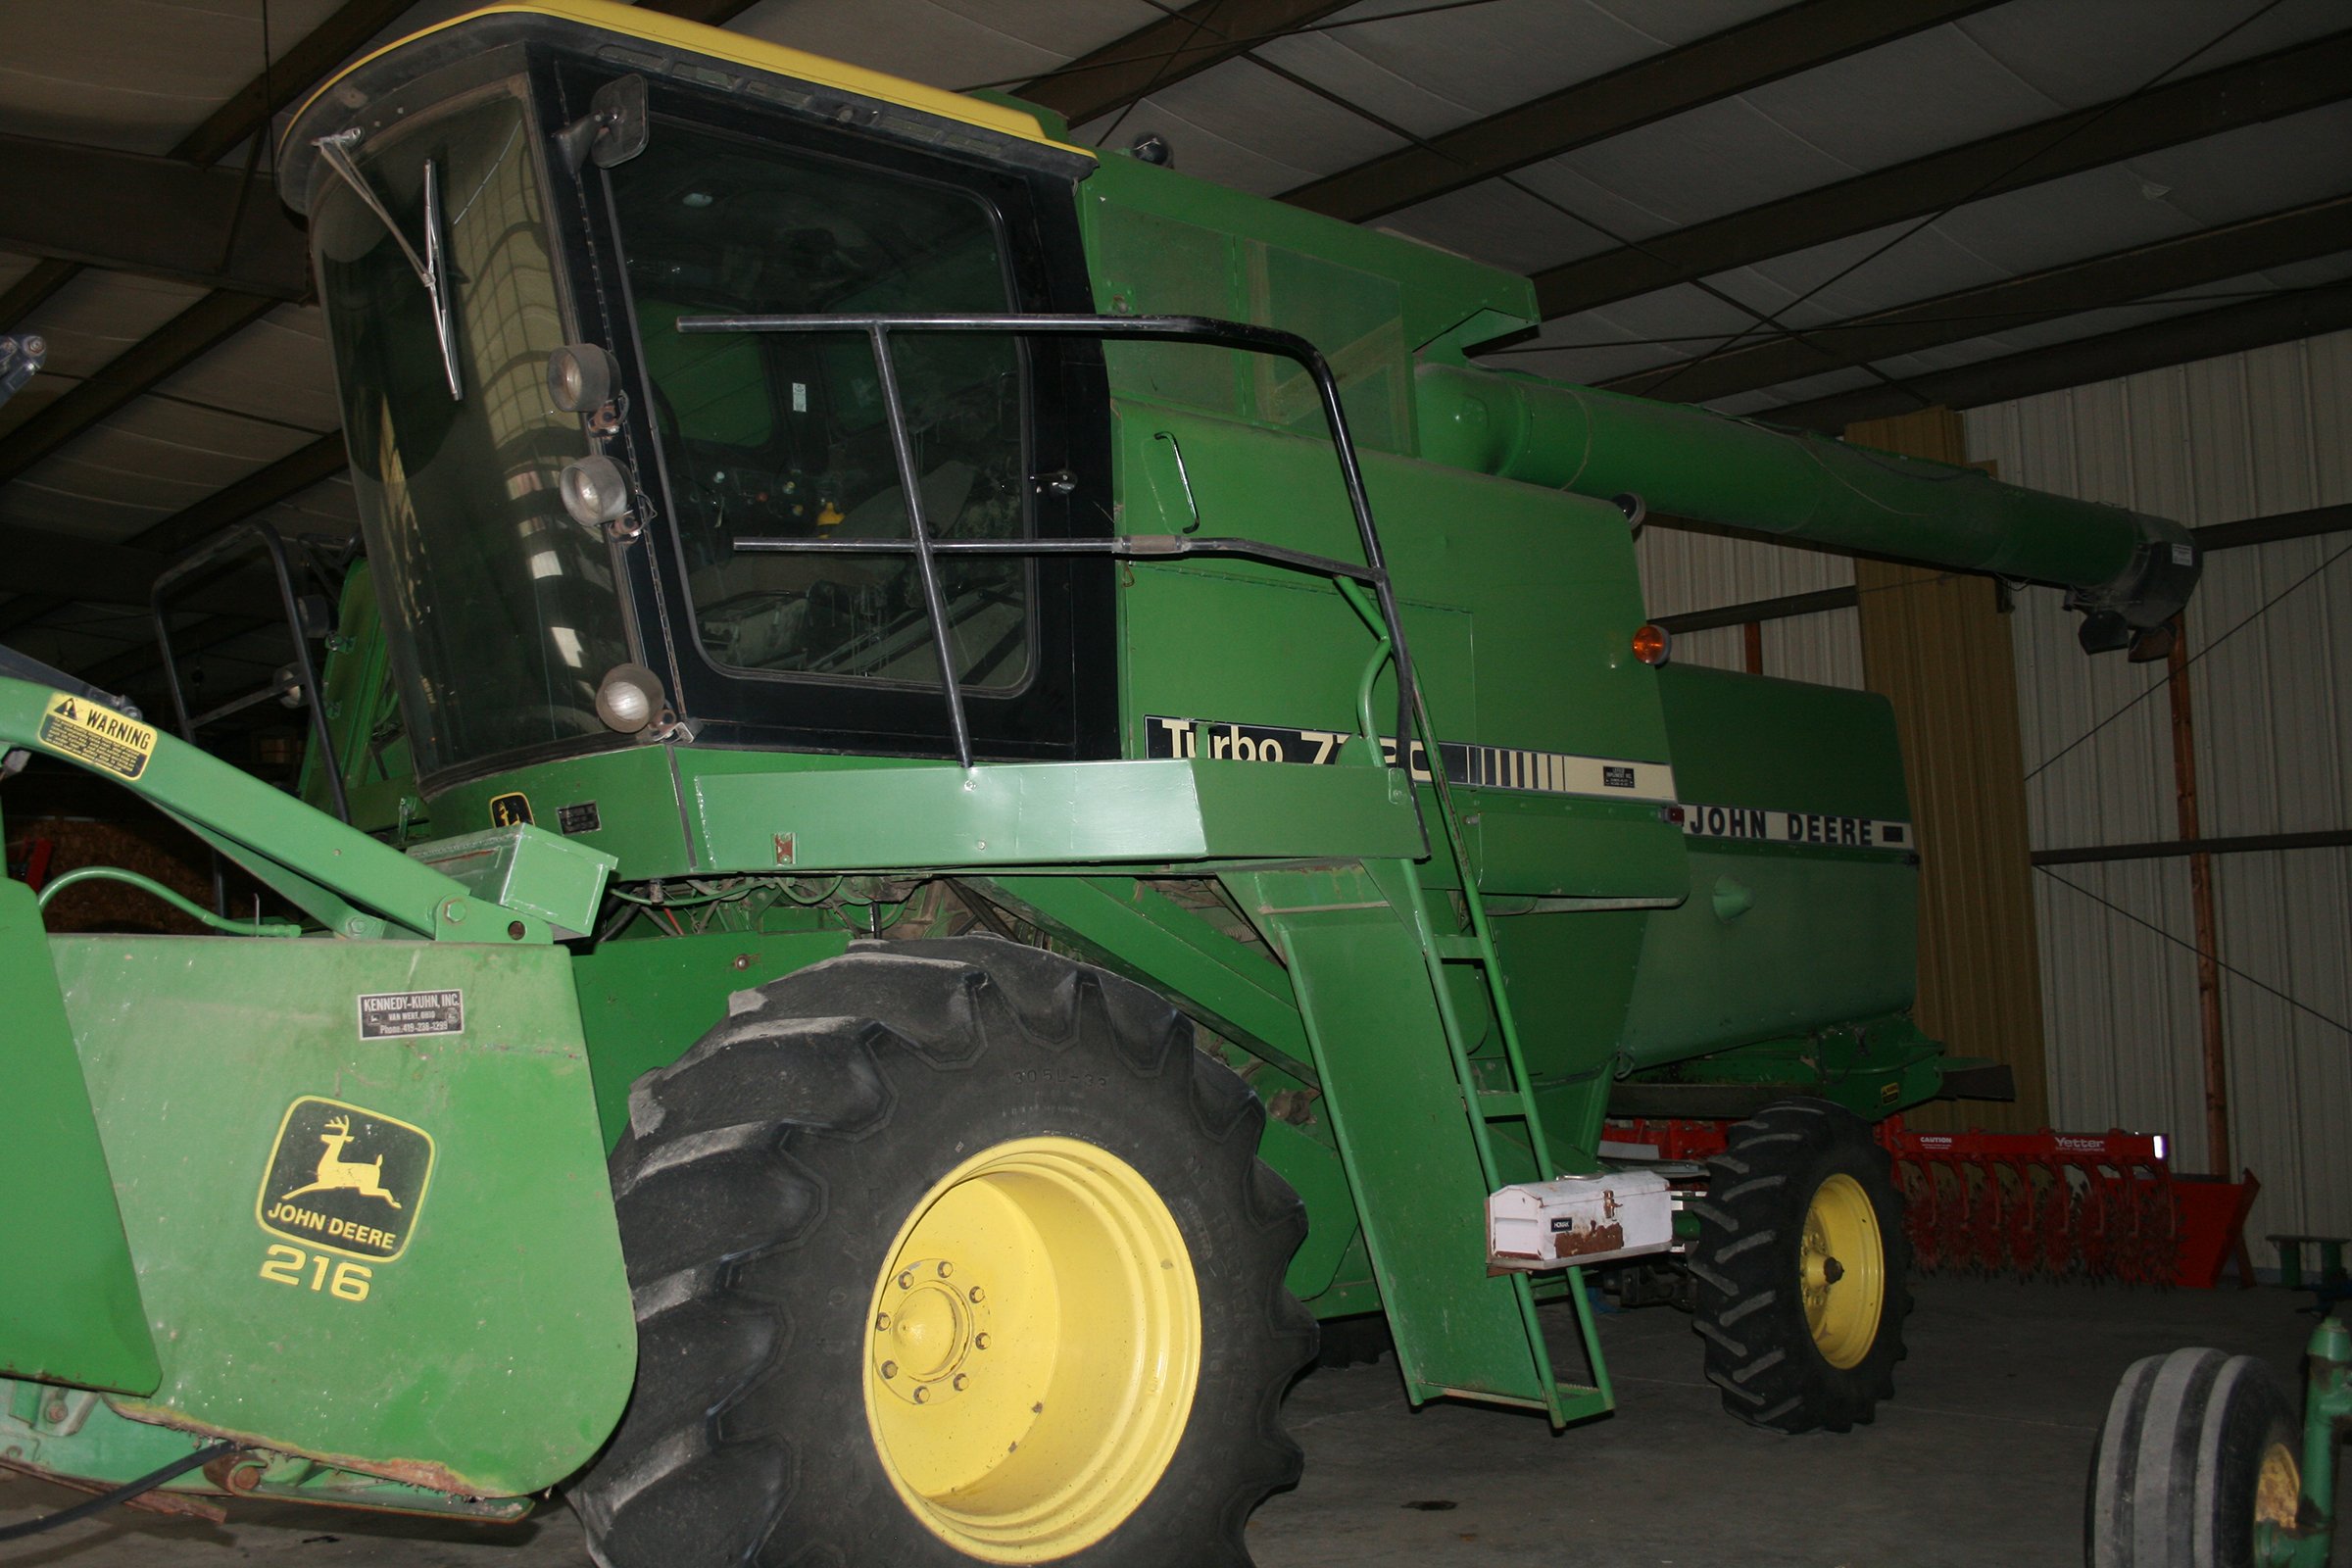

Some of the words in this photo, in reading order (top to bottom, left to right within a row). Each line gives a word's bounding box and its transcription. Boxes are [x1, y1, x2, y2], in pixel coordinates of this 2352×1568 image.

[86, 709, 151, 751] WARNING
[1690, 806, 1767, 840] JOHN
[1787, 812, 1874, 847] DEERE
[364, 994, 441, 1012] KENNEDY-KUHN,
[441, 993, 460, 1007] INC.
[2054, 1136, 2105, 1148] Yetter
[267, 1201, 326, 1232] JOHN
[327, 1217, 397, 1250] DEERE
[259, 1243, 373, 1302] 216
